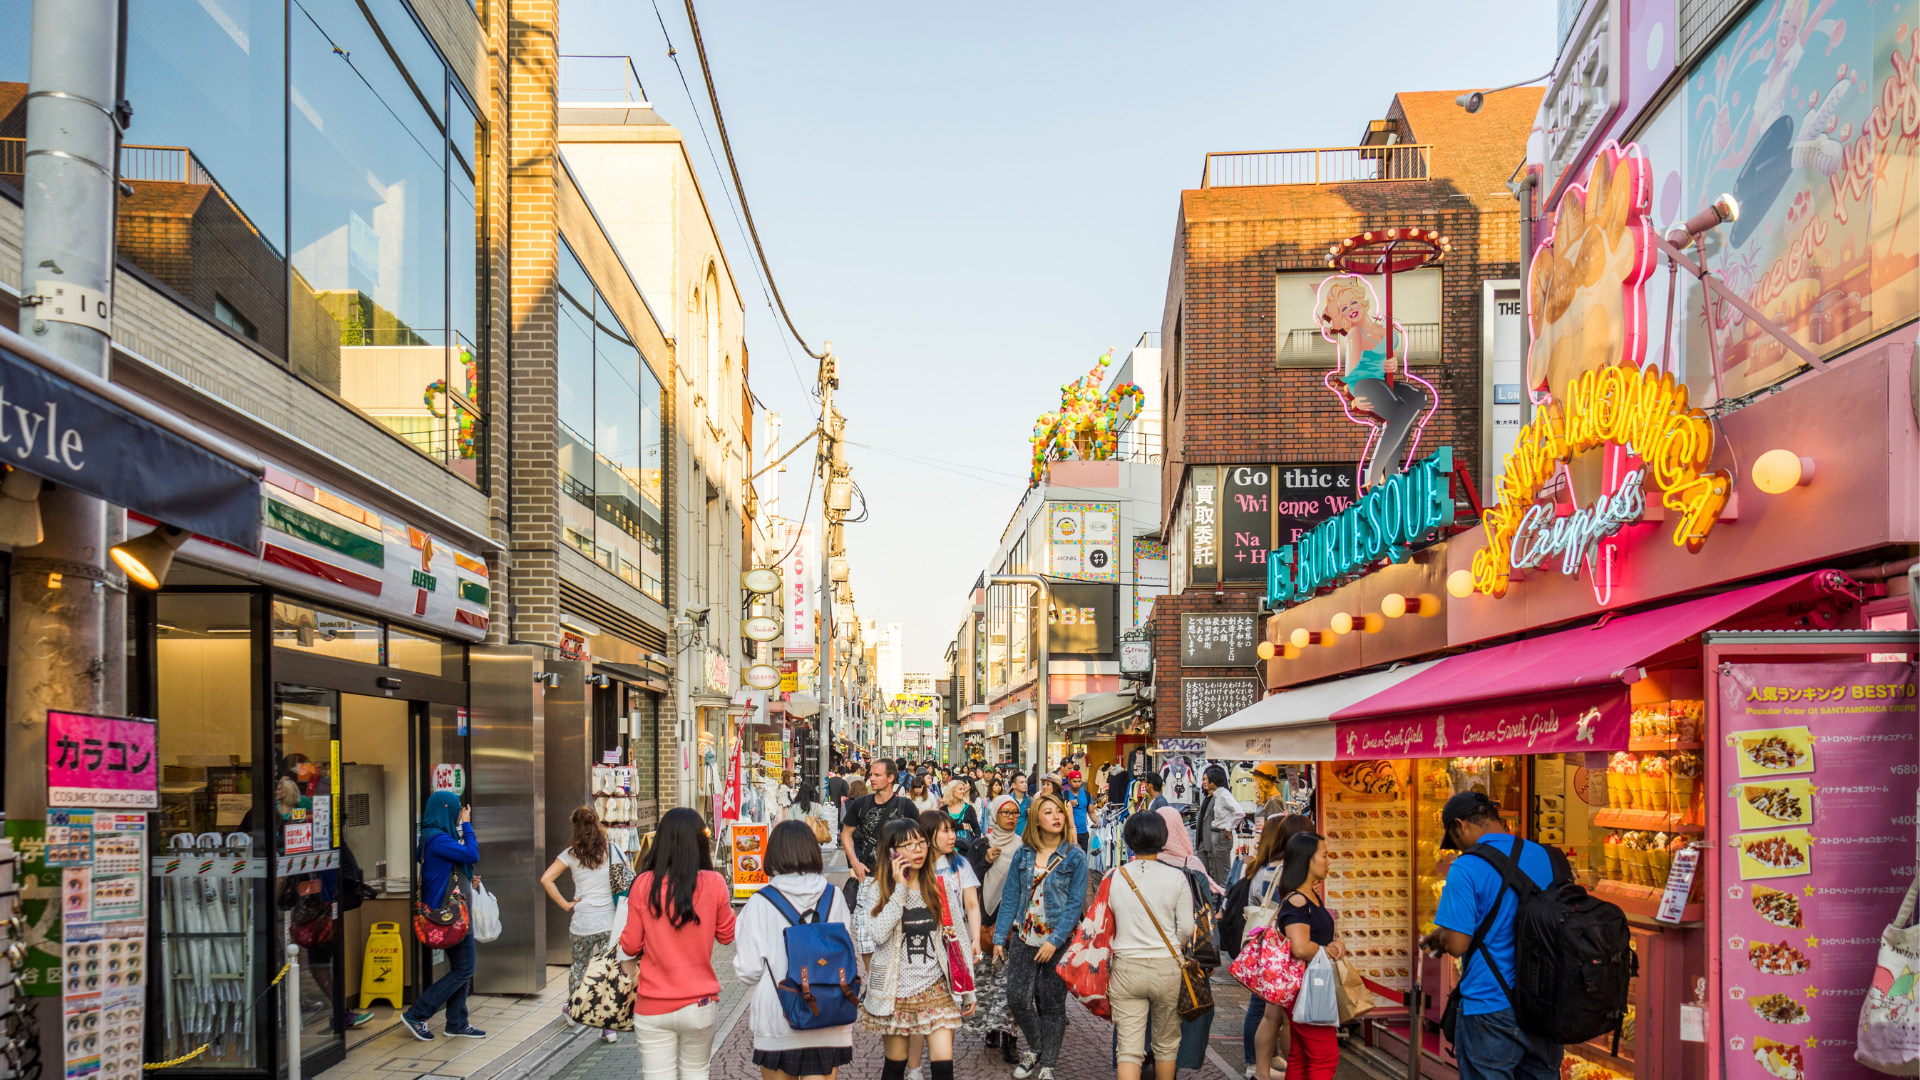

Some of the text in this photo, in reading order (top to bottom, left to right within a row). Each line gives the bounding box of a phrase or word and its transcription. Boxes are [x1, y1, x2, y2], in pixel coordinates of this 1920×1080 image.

[1786, 214, 1828, 281] on
[1498, 302, 1520, 316] THE
[1234, 468, 1268, 486] Go
[1284, 468, 1332, 488] thic
[1336, 475, 1350, 488] &
[1234, 494, 1268, 513] Vivi
[1278, 500, 1319, 518] enne
[1193, 485, 1216, 565] 買取委託
[1298, 446, 1455, 601] BURLESQUE
[1234, 532, 1260, 547] Na
[794, 543, 804, 576] NO
[794, 583, 804, 635] FALL
[1746, 683, 1916, 702] 人気ランキング BEST10
[1746, 707, 1782, 715] Popular
[1784, 707, 1805, 715] Order
[1820, 706, 1887, 715] SANTAMONICA
[1889, 704, 1916, 712] CREPE
[1462, 724, 1486, 745] Come
[1527, 708, 1559, 747] Girls
[57, 734, 151, 774] カラコン
[1890, 764, 1918, 775] ¥580
[100, 792, 134, 804] CONTACT
[135, 793, 155, 805] LENS
[1732, 889, 1738, 897] 4
[1733, 940, 1740, 948] 5
[1733, 990, 1740, 998] 6
